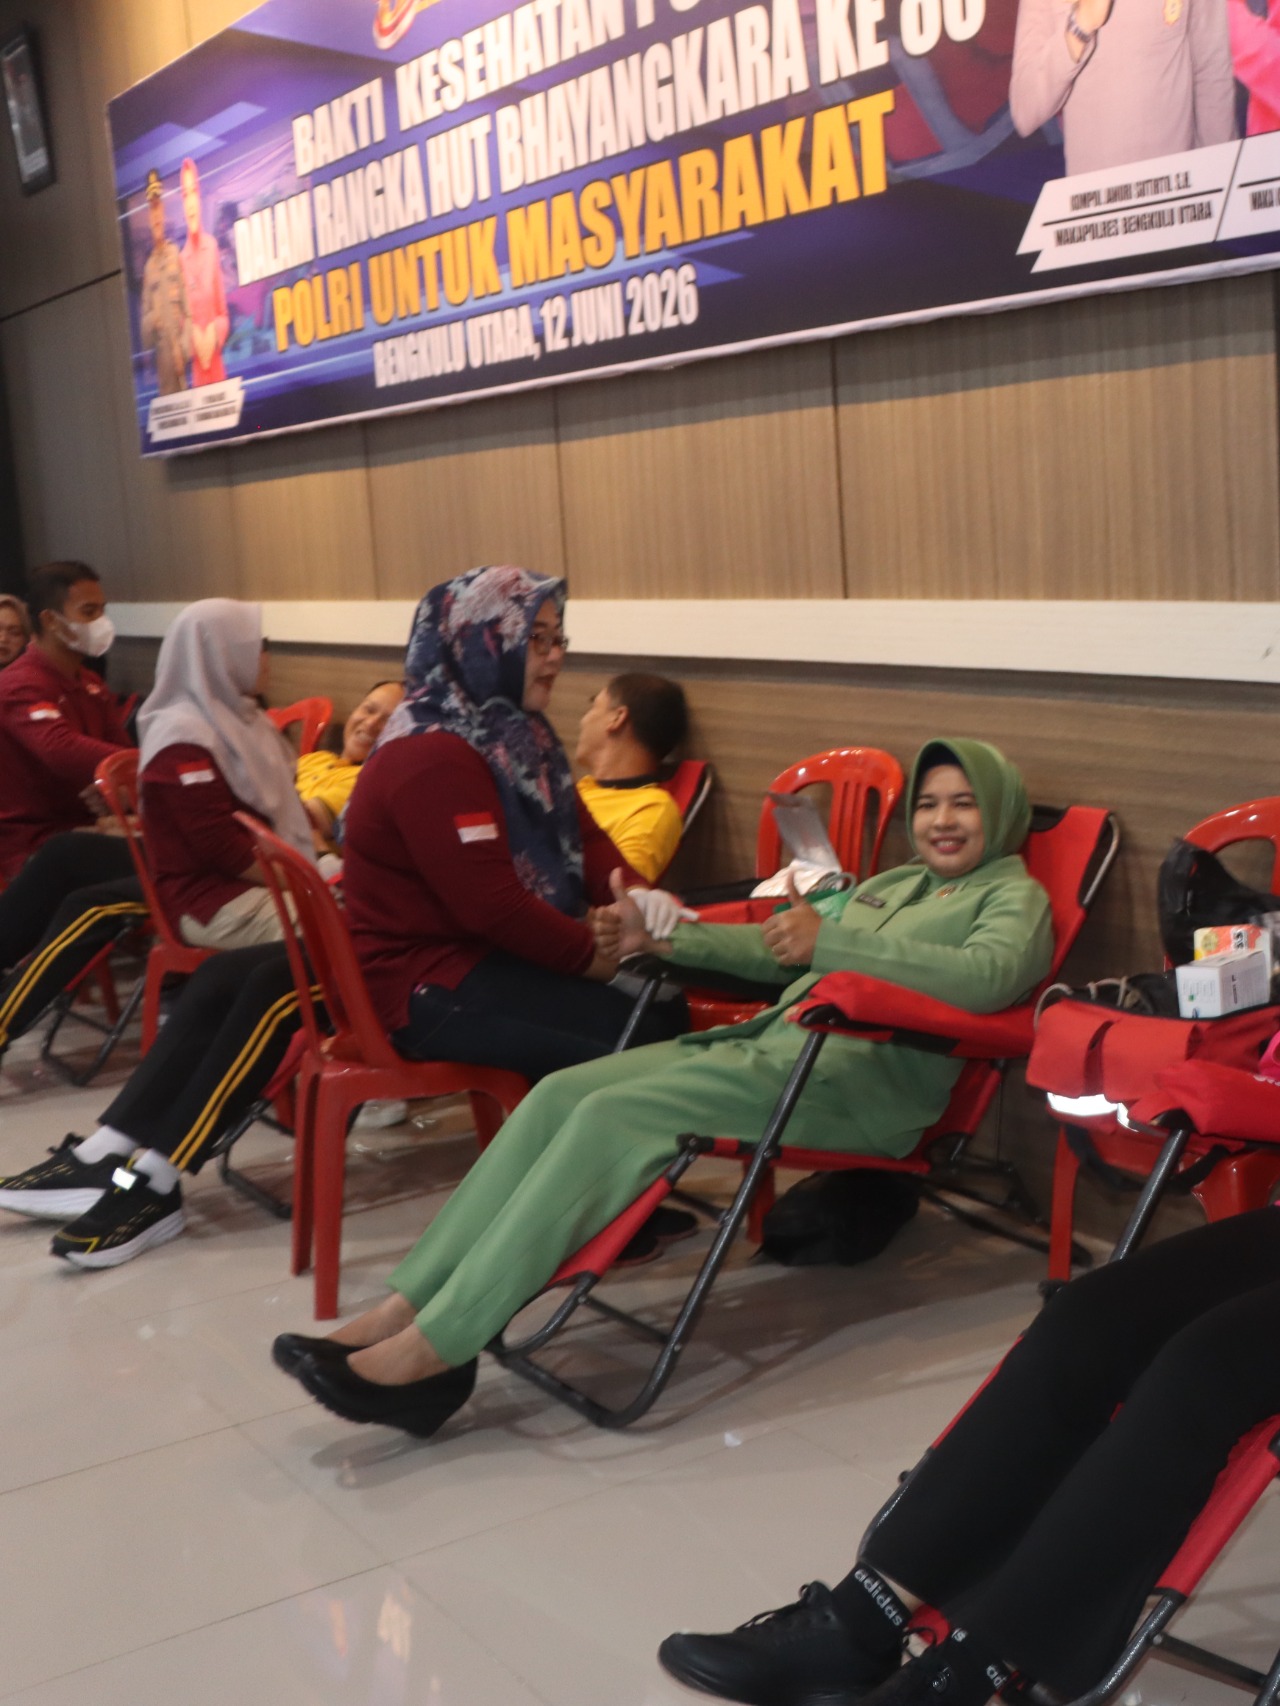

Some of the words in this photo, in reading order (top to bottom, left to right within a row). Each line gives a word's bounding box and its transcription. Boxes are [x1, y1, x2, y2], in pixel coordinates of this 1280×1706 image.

[234, 190, 315, 286] DALAM
[313, 144, 428, 258] RANGKA
[426, 114, 492, 218] HUT
[495, 0, 810, 194] BHAYANGKARA
[815, 0, 890, 86] KE
[292, 77, 386, 177] BAKTI
[395, 0, 626, 132] KESEHATAN
[272, 262, 365, 354] POLRI
[368, 215, 502, 325] UNTUK
[506, 89, 895, 289] MASYARAKAT
[1122, 207, 1175, 235] BENGKULU
[373, 320, 466, 389] BENGKULU
[466, 303, 541, 368] UTARA,
[539, 294, 569, 352] 12
[570, 281, 625, 347] JUNI
[626, 262, 699, 336] 2026
[854, 1568, 903, 1626] adidas
